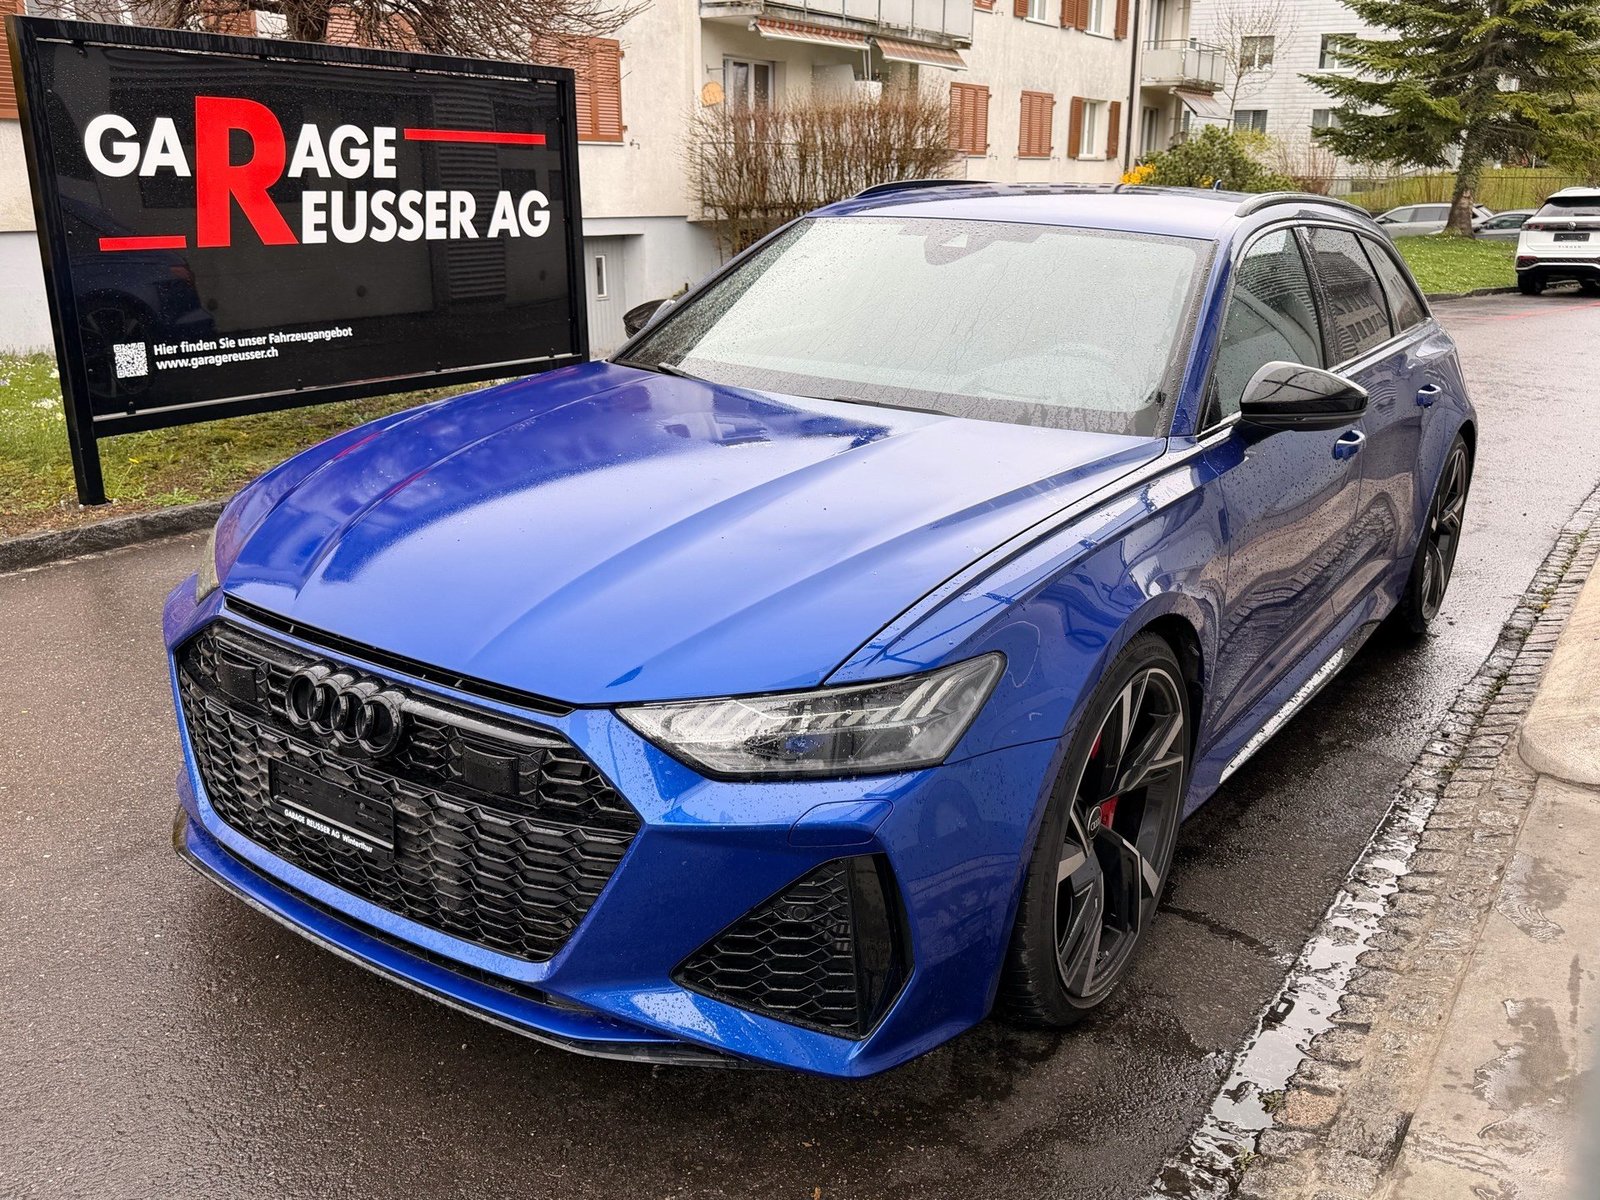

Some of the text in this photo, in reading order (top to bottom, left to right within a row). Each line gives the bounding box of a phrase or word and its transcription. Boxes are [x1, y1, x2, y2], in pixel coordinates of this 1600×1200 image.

[84, 96, 397, 248] GARAGE
[487, 189, 551, 240] AG
[153, 326, 353, 356] Hier finden Sie unser Fahrzeugangebot
[155, 346, 279, 371] www.garagereusser.ch
[284, 808, 374, 853] GARAGE REUSSER AG Winterthur
